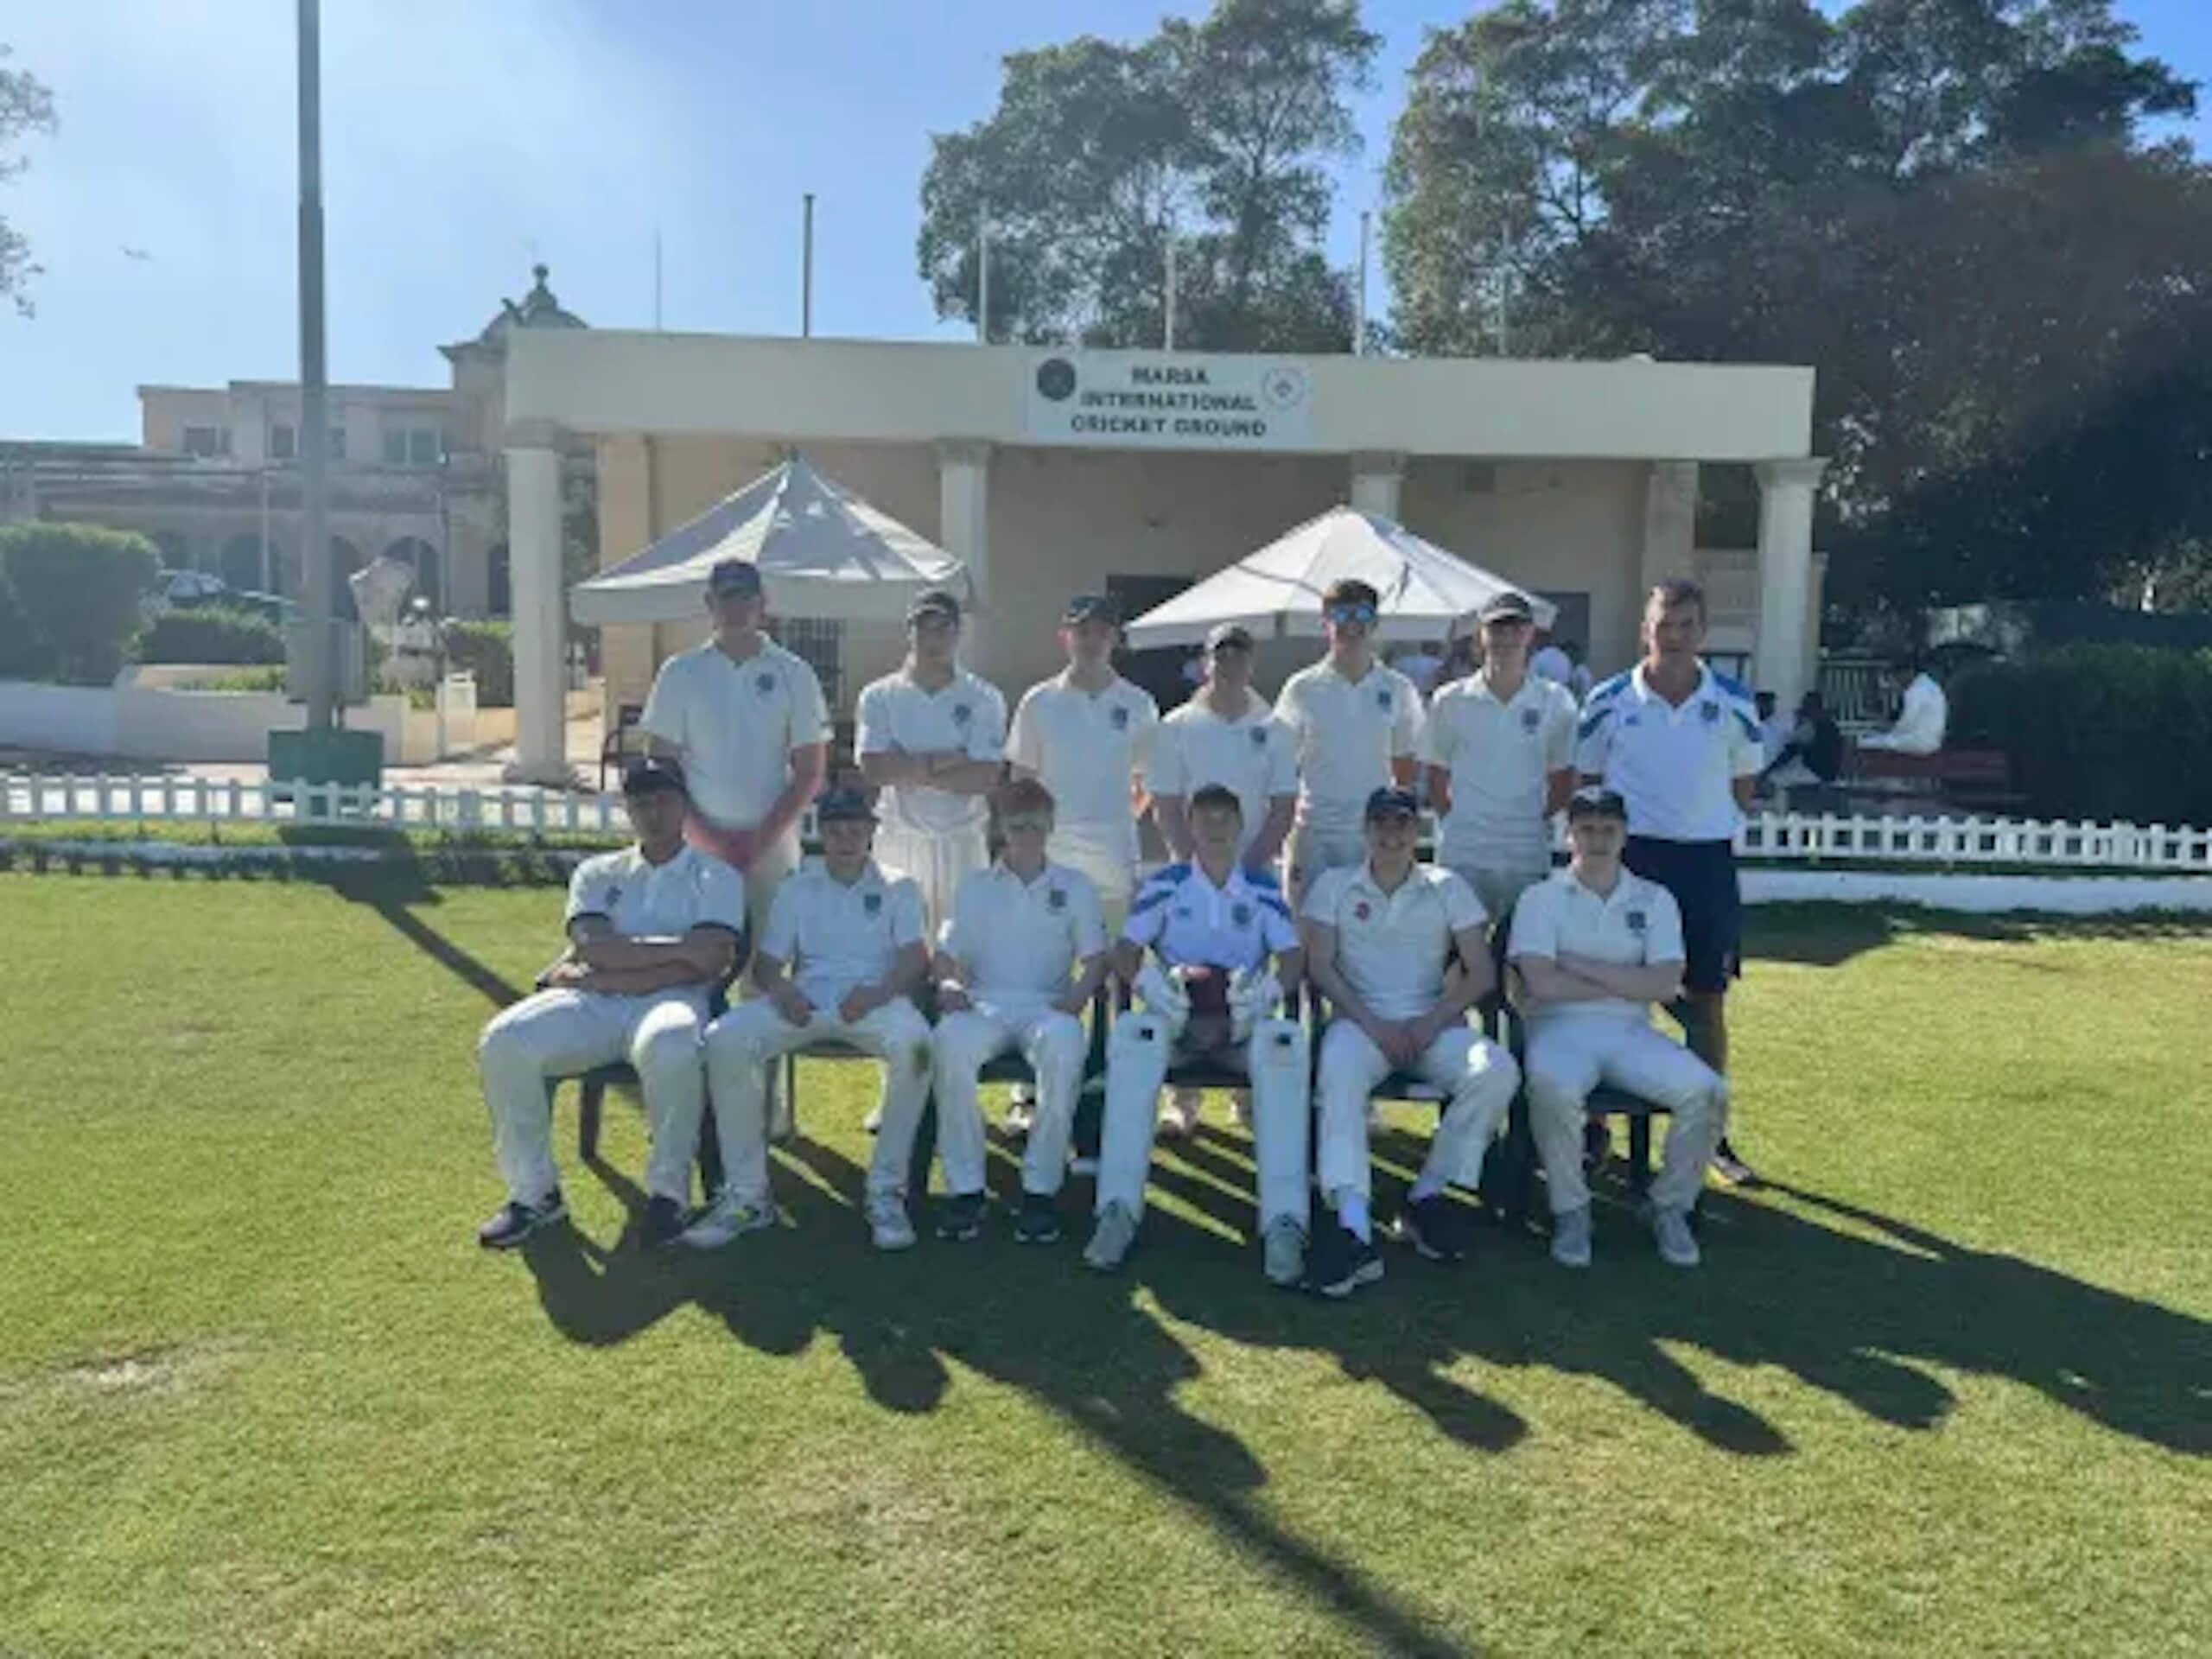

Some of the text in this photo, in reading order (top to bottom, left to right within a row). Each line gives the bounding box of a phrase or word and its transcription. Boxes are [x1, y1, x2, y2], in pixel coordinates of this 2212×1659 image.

[1131, 365, 1210, 385] MARSA
[1080, 389, 1257, 411] INTERNATIONAL
[1071, 414, 1268, 438] CRICKET GROUND
